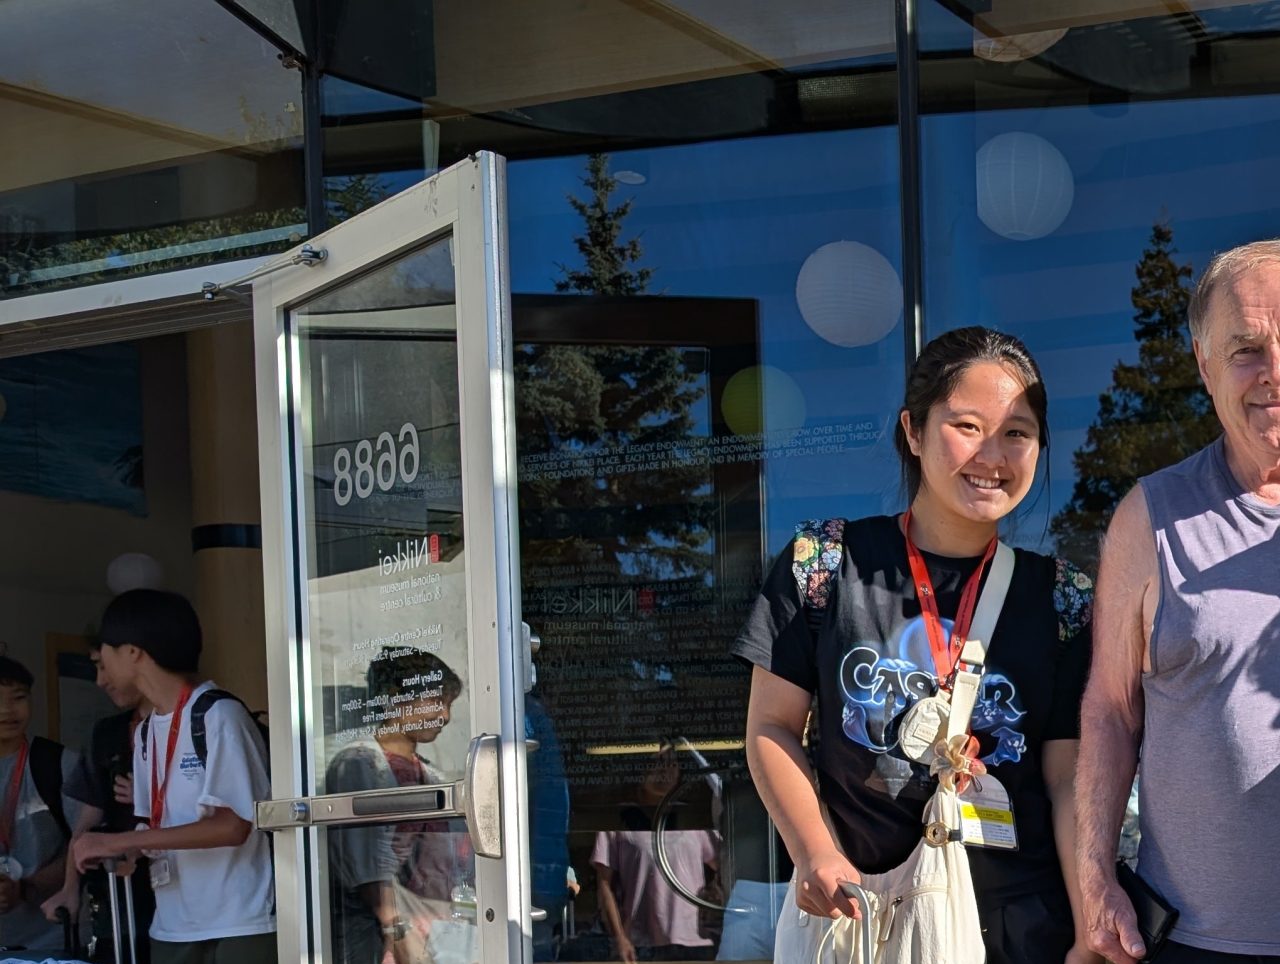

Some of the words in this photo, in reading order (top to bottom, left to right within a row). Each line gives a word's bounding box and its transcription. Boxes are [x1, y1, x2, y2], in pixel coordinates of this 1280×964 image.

[528, 460, 558, 472] SERVICES
[560, 459, 570, 469] OF
[624, 452, 644, 463] EACH
[646, 450, 666, 461] YEAR
[666, 449, 682, 460] THE
[682, 446, 710, 458] LEGACY
[712, 441, 762, 455] ENDOWMENT
[764, 440, 780, 451] HAS
[782, 438, 802, 449] BEEN
[804, 434, 846, 447] SUPPORTED
[594, 446, 610, 457] FOR
[612, 445, 626, 455] THE
[626, 442, 654, 454] LEGACY
[708, 436, 720, 446] AN
[812, 426, 834, 437] OVER
[836, 424, 854, 434] TIME
[854, 422, 874, 433] AND
[544, 466, 594, 480] FOUNDATIONS
[596, 465, 614, 475] AND
[614, 462, 636, 474] GIFTS
[638, 460, 660, 472] MADE
[662, 459, 670, 469] IN
[670, 456, 704, 469] HONOUR
[708, 454, 724, 465] AND
[726, 453, 736, 464] IN
[738, 450, 770, 463] MEMORY
[772, 449, 782, 459] OF
[786, 446, 814, 458] SPECIAL
[840, 647, 1027, 722] CASR
